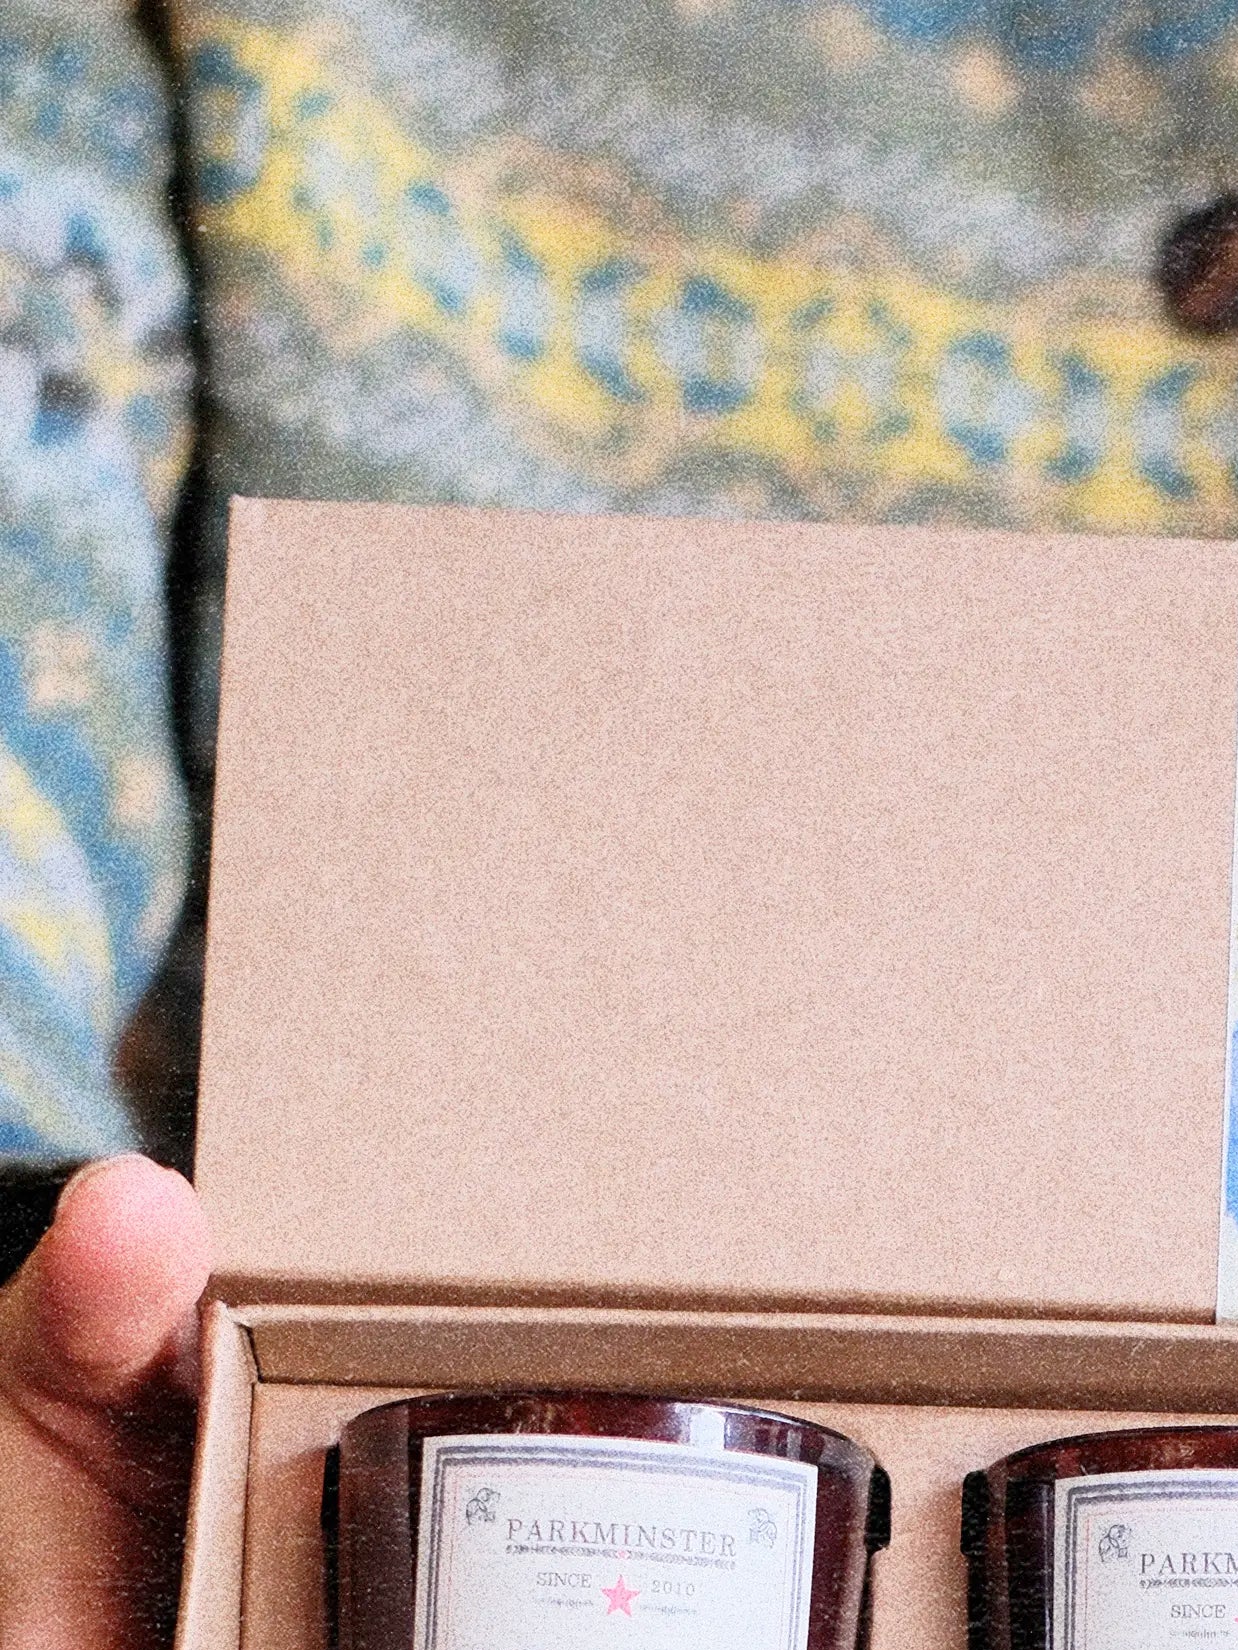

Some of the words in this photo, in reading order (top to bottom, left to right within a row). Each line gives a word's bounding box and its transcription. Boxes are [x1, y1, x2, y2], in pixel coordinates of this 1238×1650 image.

[507, 1518, 737, 1557] PARKMINSTER
[537, 1572, 591, 1588] SINCE
[652, 1580, 695, 1596] 2010
[1171, 1605, 1226, 1619] SINCE
